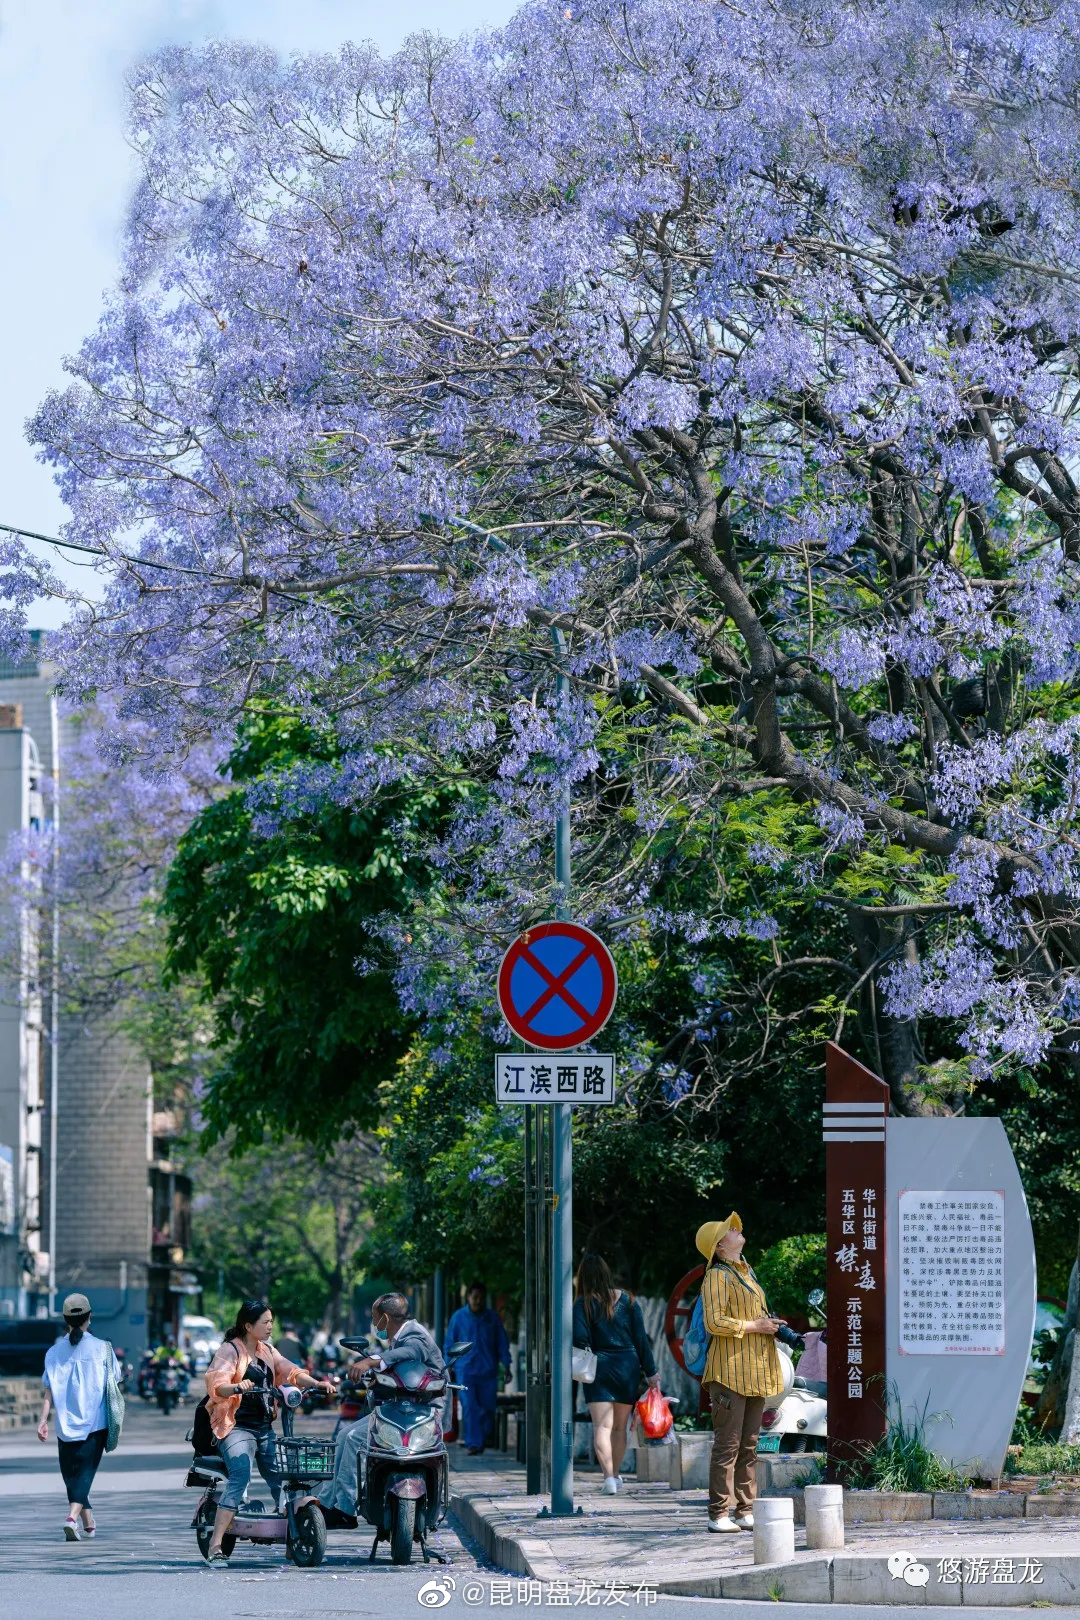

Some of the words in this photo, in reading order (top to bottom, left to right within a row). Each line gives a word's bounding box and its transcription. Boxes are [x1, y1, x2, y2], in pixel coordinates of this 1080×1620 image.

[504, 1065, 605, 1094] 江滨西路
[842, 1189, 856, 1235] 五华区
[862, 1188, 877, 1250] 华山街道
[834, 1243, 876, 1291] 禁毒
[847, 1298, 862, 1398] 示范主题公园
